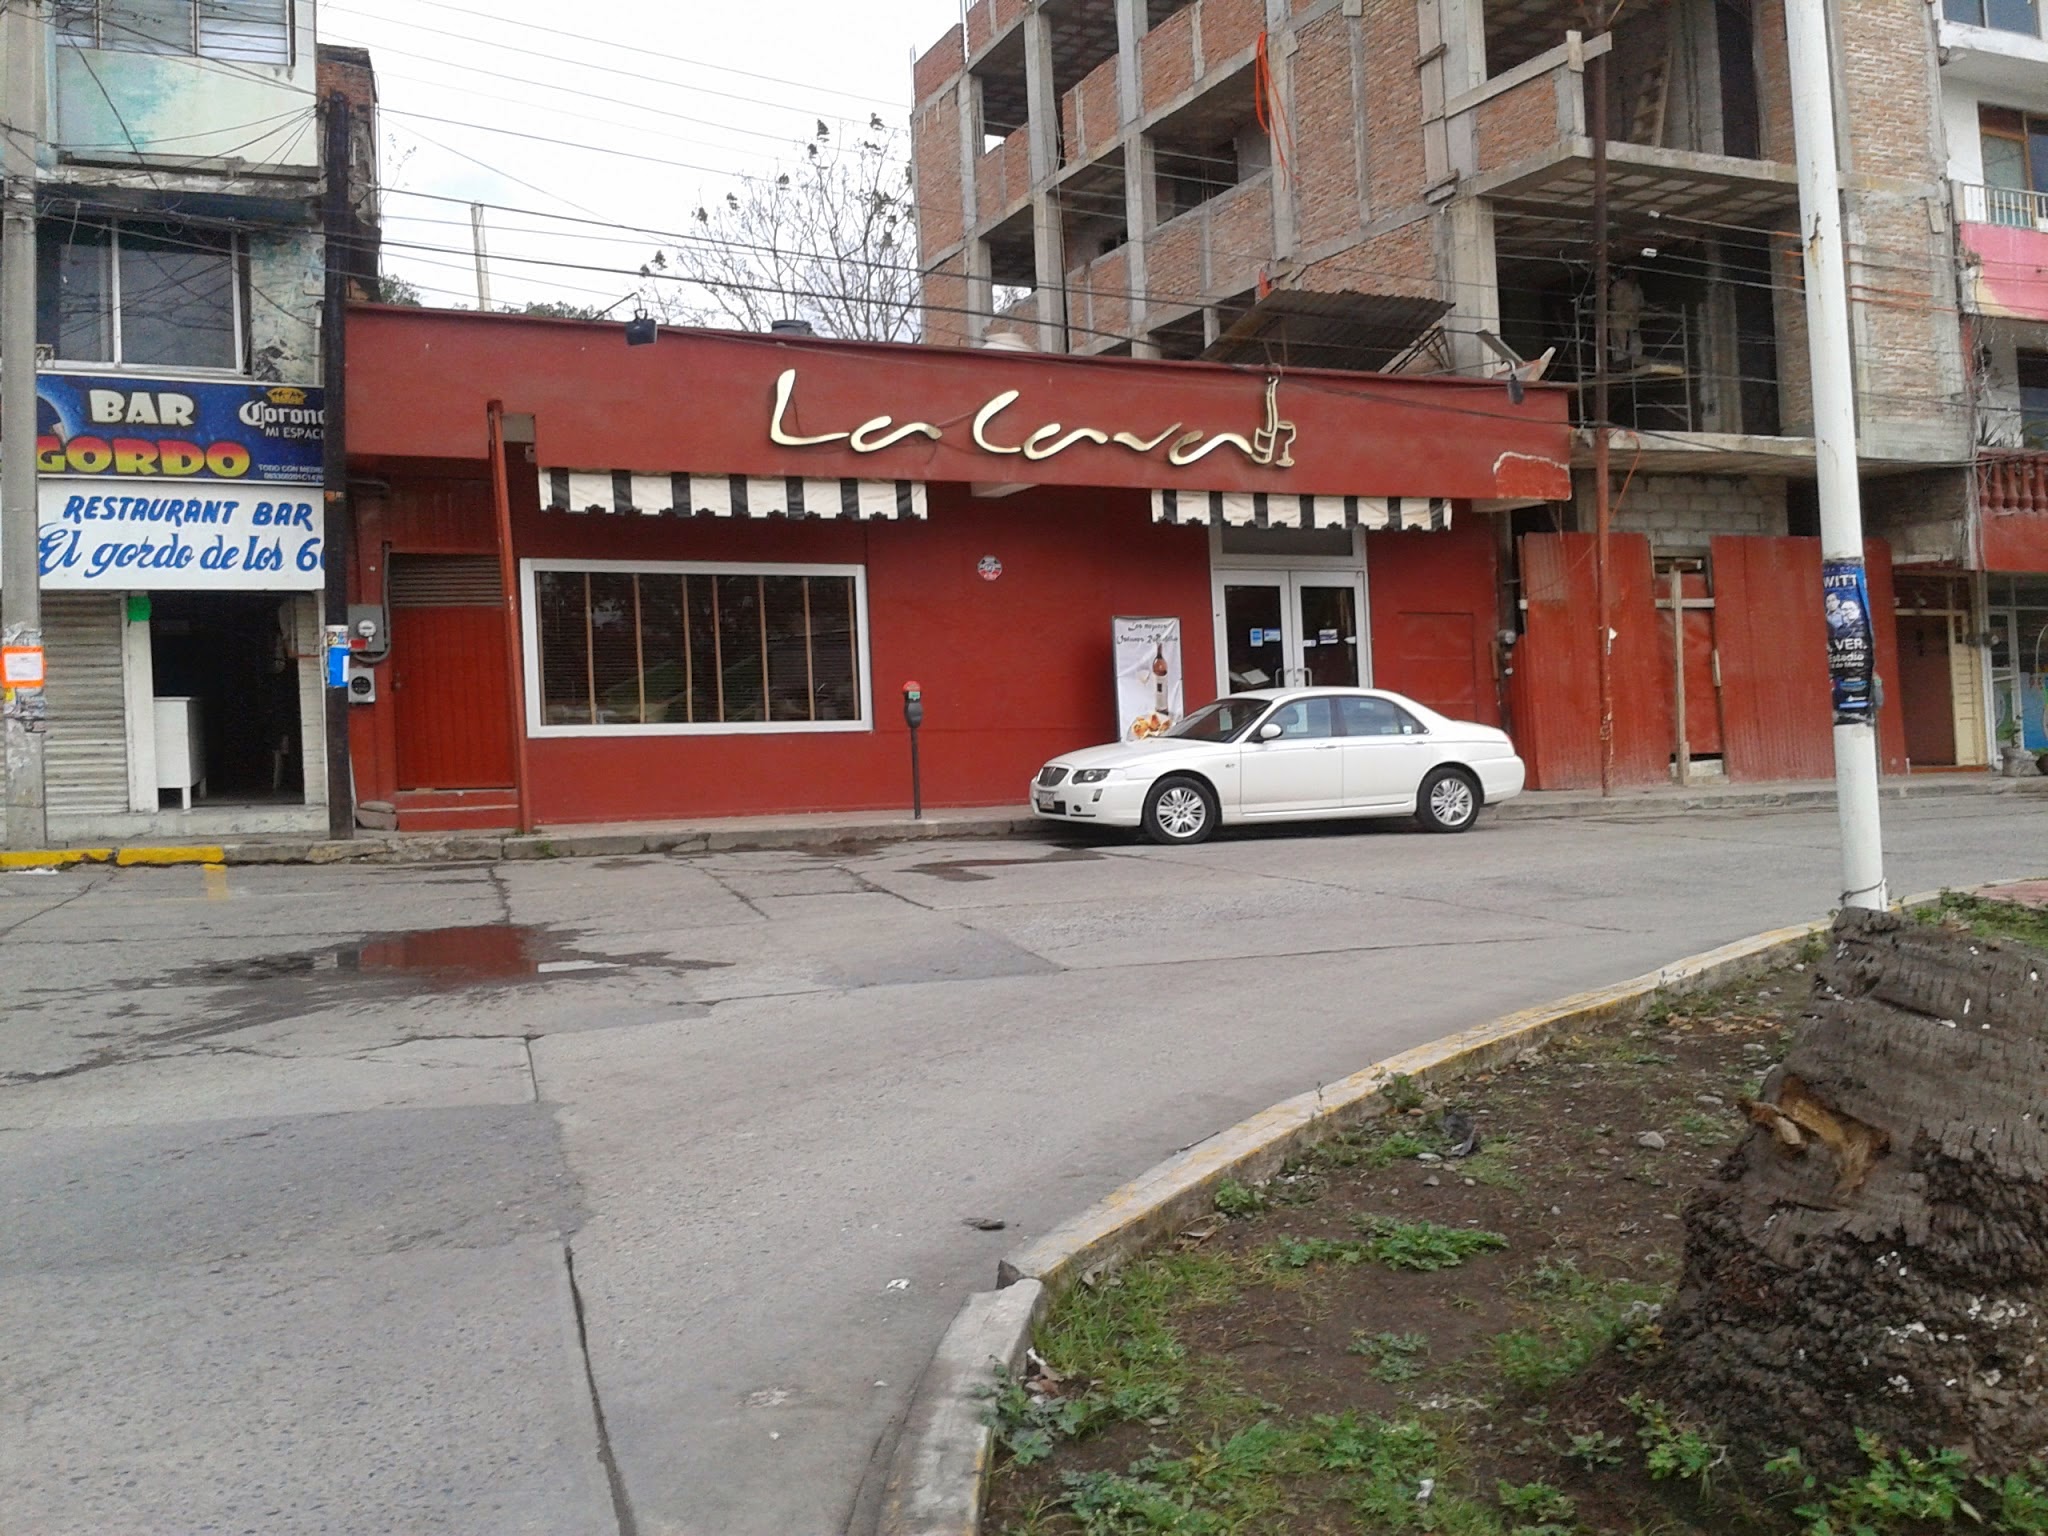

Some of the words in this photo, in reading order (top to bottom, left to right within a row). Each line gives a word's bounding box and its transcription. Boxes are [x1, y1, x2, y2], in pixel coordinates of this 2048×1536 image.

[89, 389, 195, 426] BAR
[769, 368, 943, 454] La
[973, 388, 1256, 466] Cava
[265, 427, 280, 438] MI
[38, 435, 251, 478] GORDO
[63, 495, 240, 528] RESTAURANT
[251, 501, 314, 531] BAR
[38, 522, 83, 577] El
[84, 533, 195, 578] gordo
[199, 534, 240, 570] de
[242, 535, 287, 571] los
[1834, 637, 1868, 651] VER.
